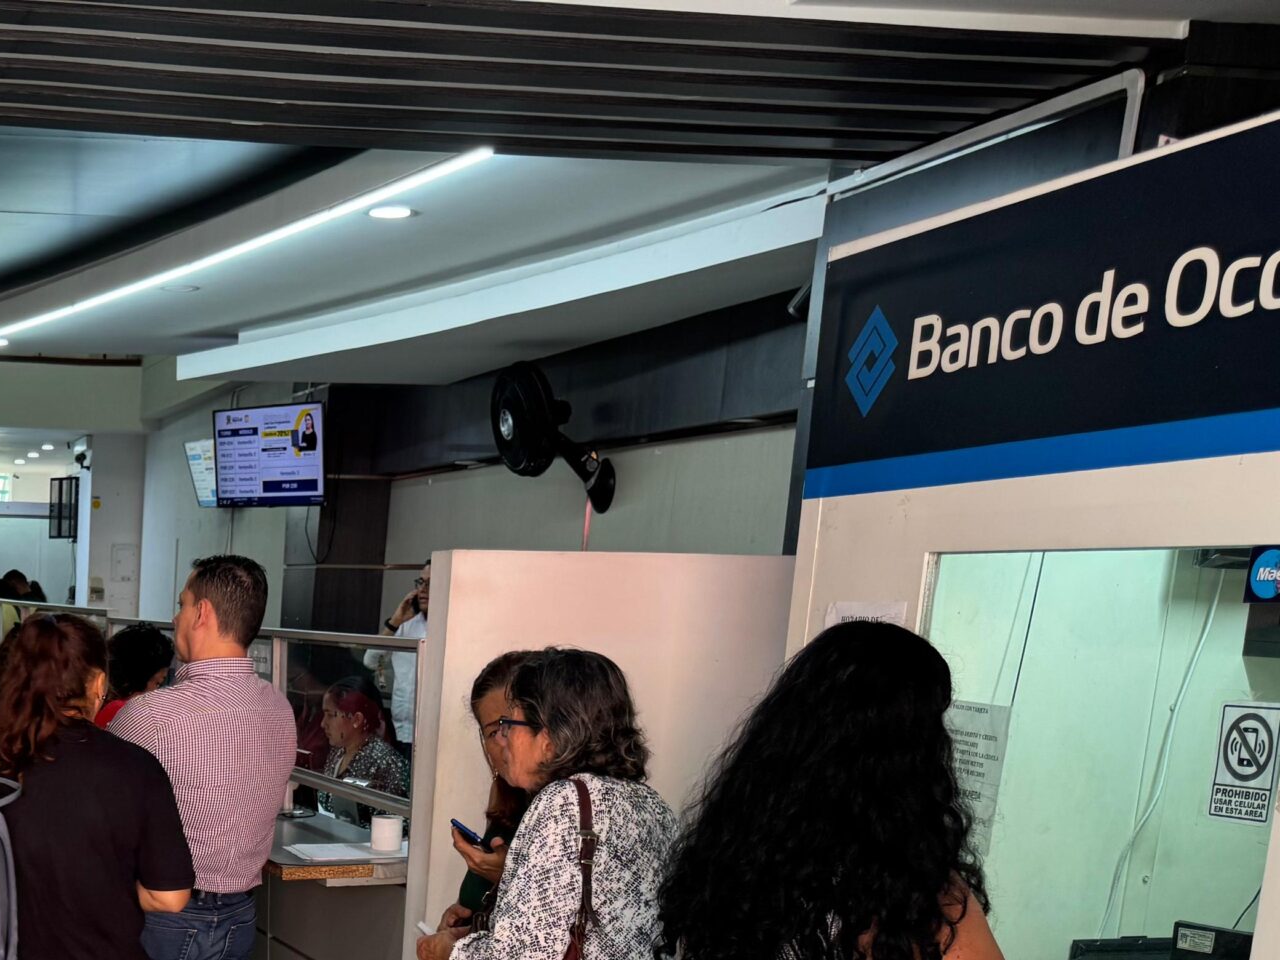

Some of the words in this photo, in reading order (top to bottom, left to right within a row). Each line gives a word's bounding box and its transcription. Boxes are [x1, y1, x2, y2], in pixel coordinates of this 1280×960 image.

[907, 302, 1063, 380] Banco
[1075, 268, 1150, 345] de
[1214, 787, 1268, 802] PROHIBIDO
[1213, 798, 1233, 807] USAR
[1234, 800, 1266, 811] CELULAR
[1214, 805, 1224, 813] EN
[1225, 807, 1243, 815] ESTA
[1244, 809, 1263, 818] AREA
